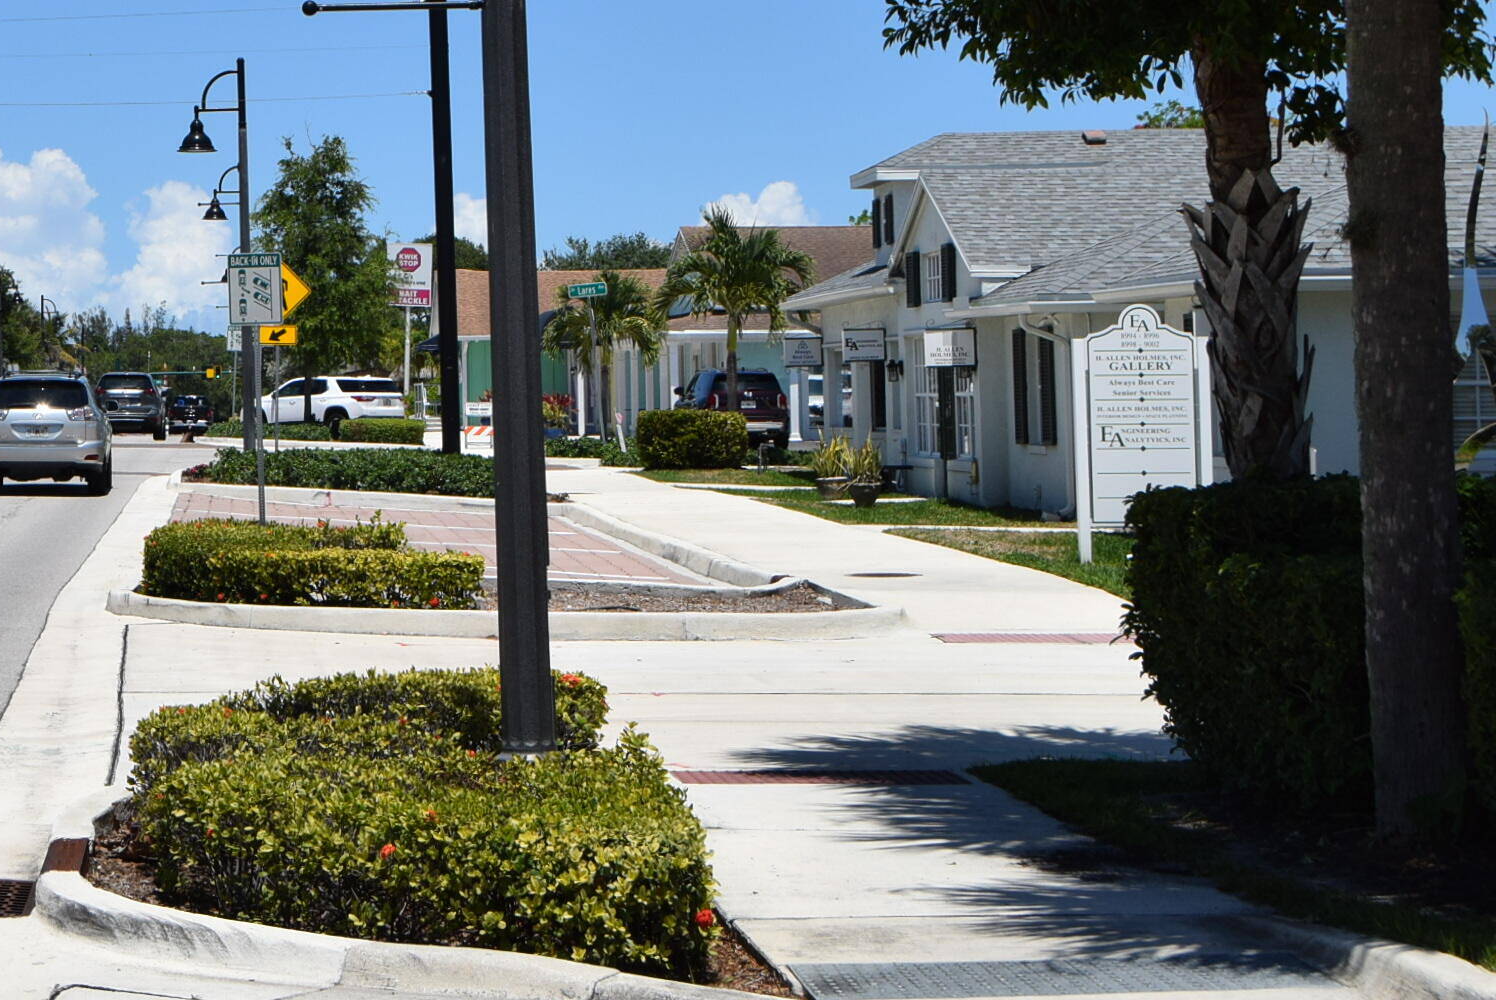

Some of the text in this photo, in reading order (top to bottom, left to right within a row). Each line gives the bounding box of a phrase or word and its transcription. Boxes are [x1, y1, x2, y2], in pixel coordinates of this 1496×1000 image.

[230, 255, 278, 266] BACK-IN ONLY
[1109, 361, 1173, 371] GALLERY
[1109, 379, 1136, 388] Always
